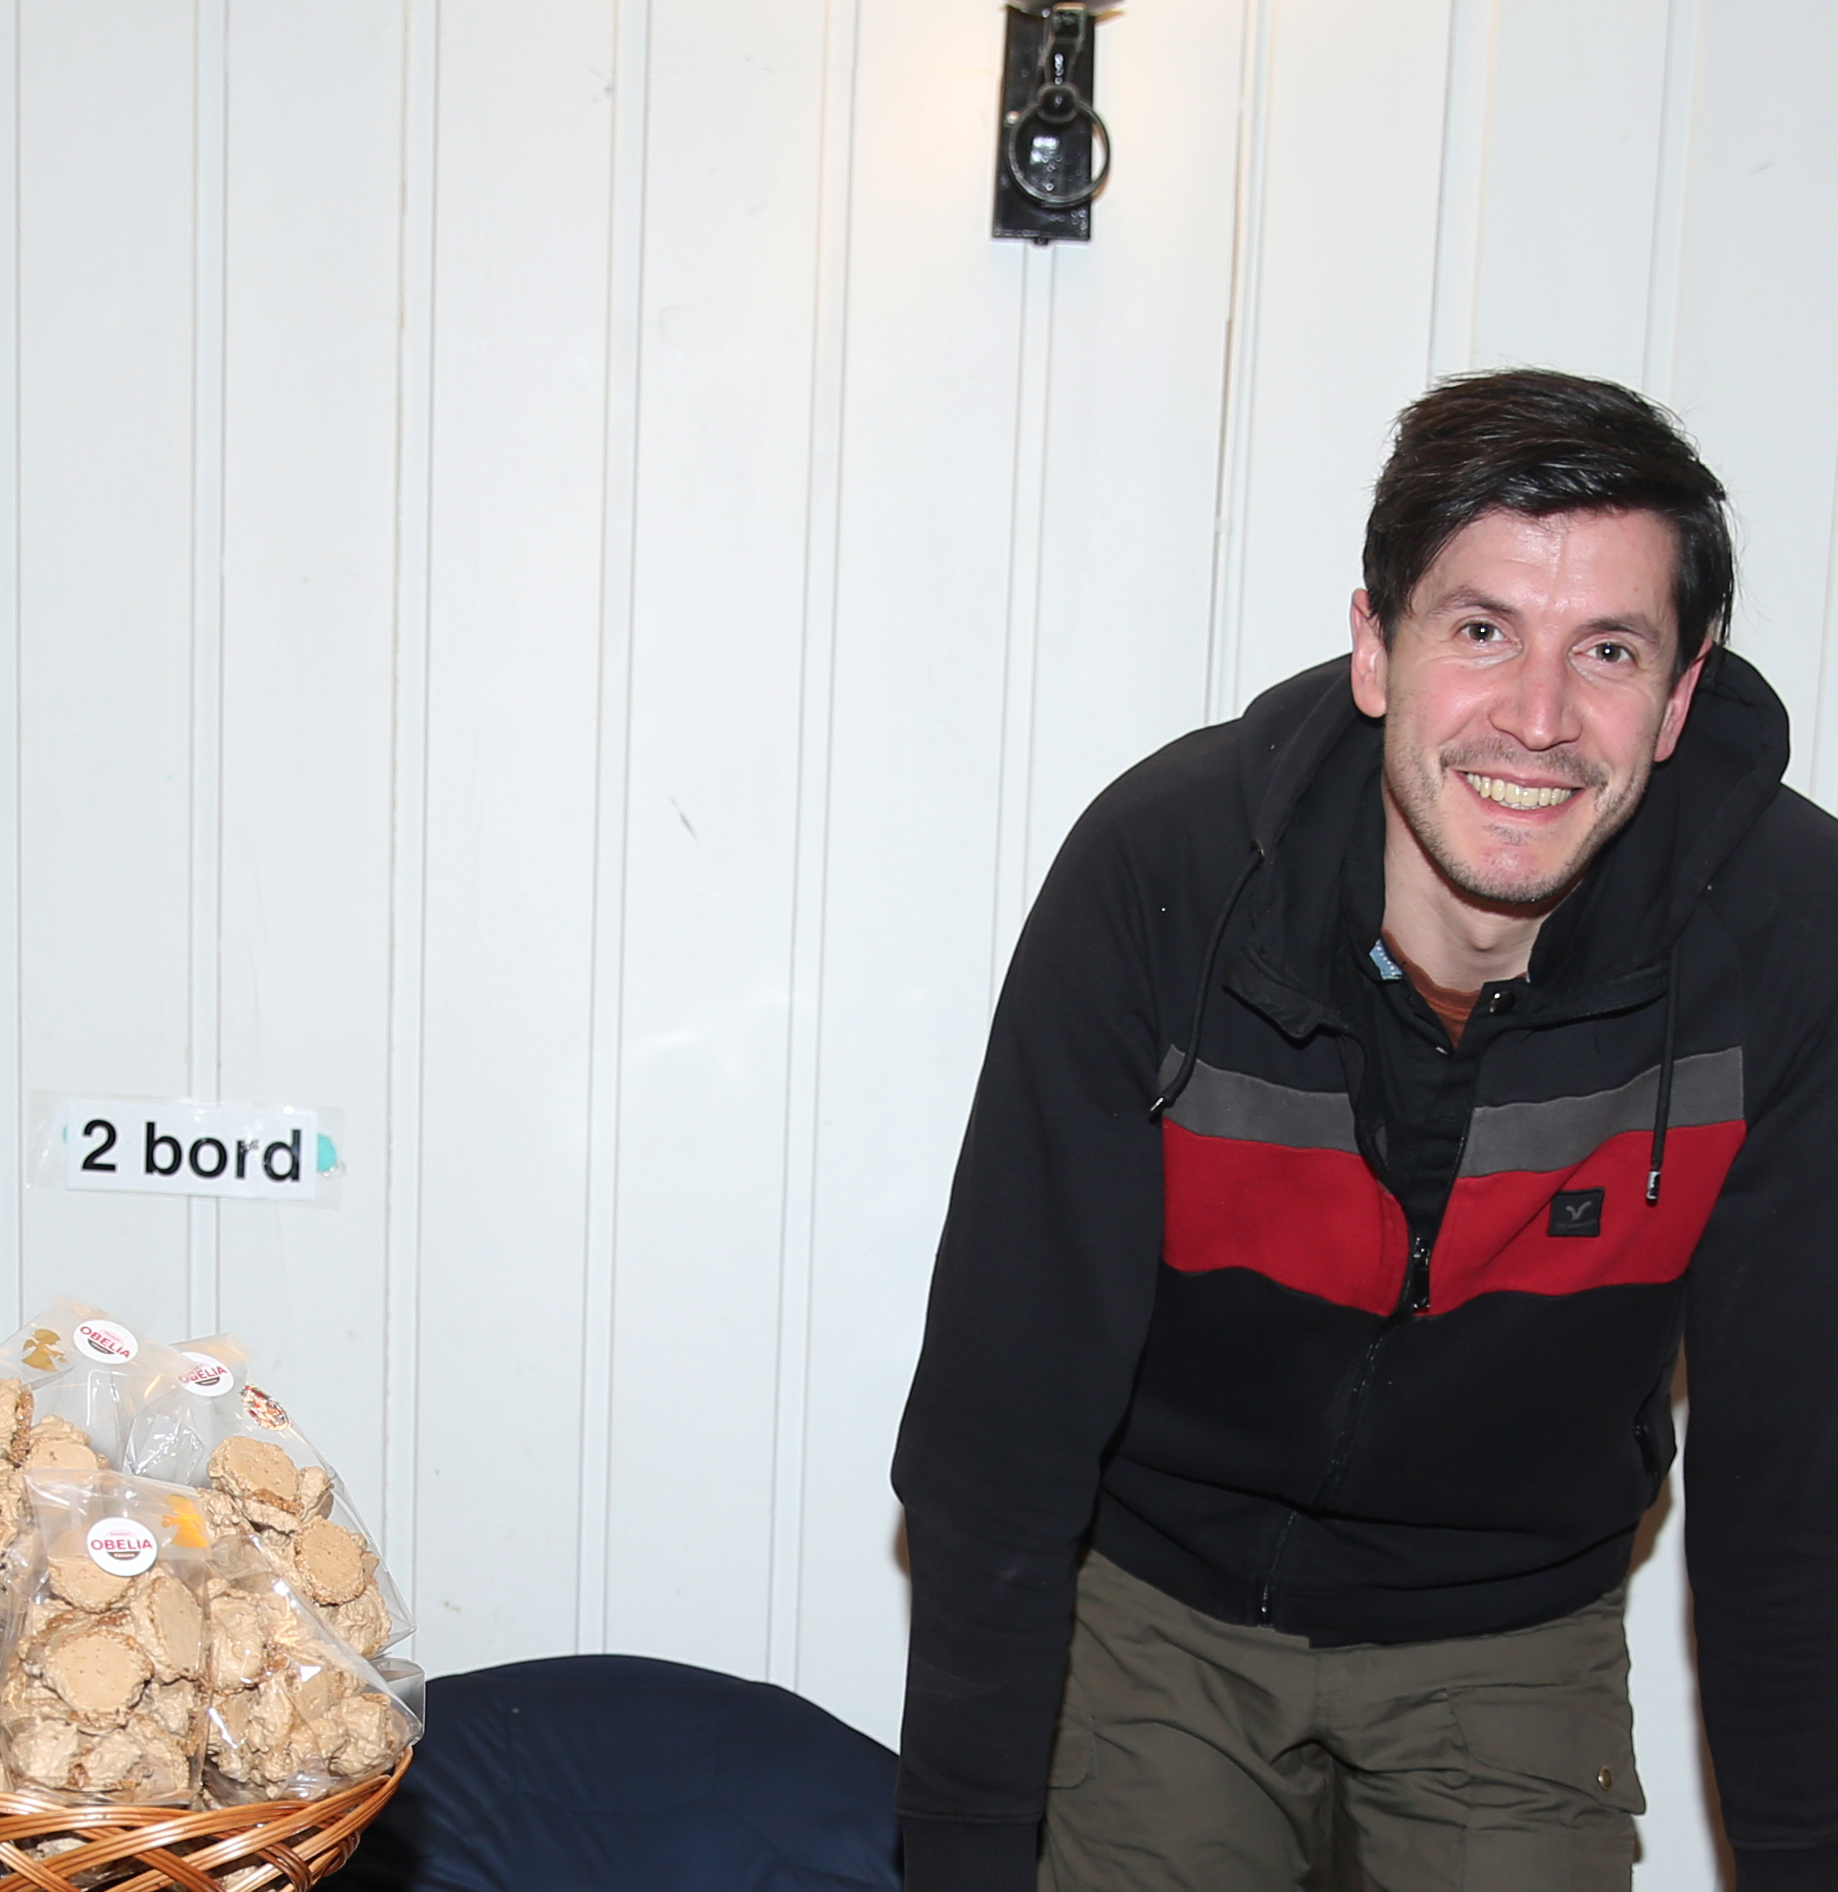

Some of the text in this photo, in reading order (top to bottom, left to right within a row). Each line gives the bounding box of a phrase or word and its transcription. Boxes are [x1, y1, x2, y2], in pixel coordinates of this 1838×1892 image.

[80, 1118, 302, 1183] 2 bord
[79, 1325, 131, 1359] OBELIA
[178, 1364, 228, 1385] OBELIA
[90, 1538, 154, 1551] OBELIA
